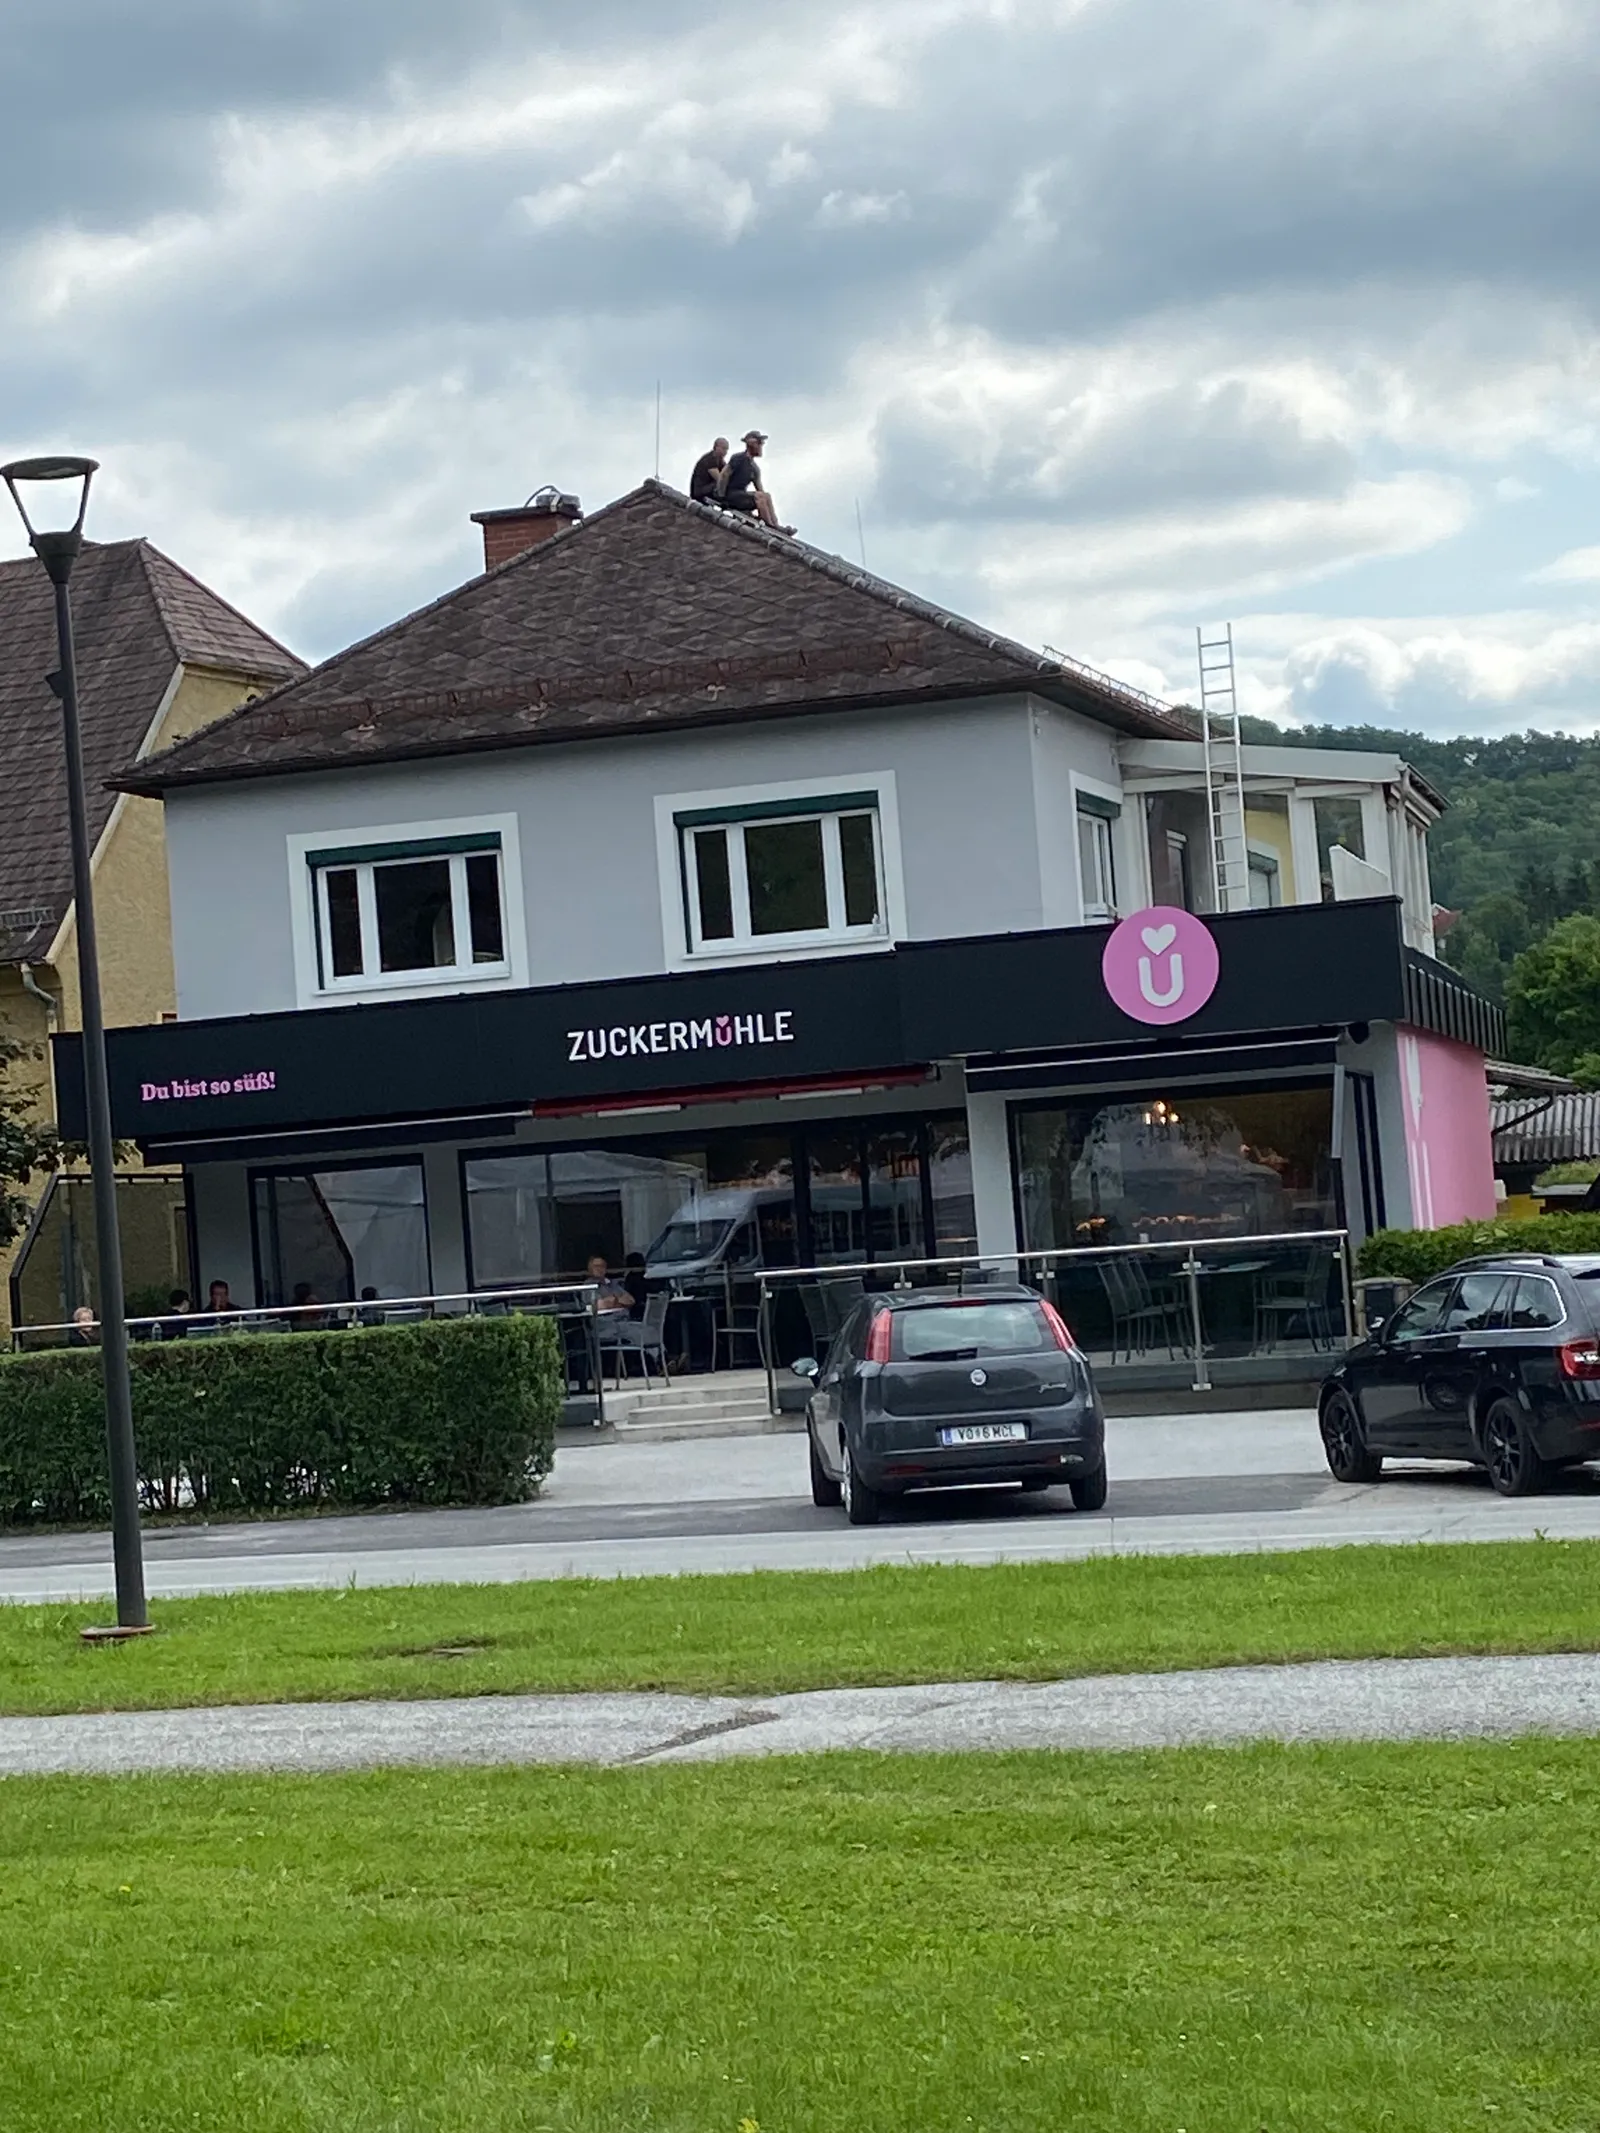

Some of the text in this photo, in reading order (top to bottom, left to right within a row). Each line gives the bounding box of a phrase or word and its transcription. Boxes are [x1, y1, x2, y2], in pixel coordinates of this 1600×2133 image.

[141, 1071, 276, 1101] Du bist so süß!
